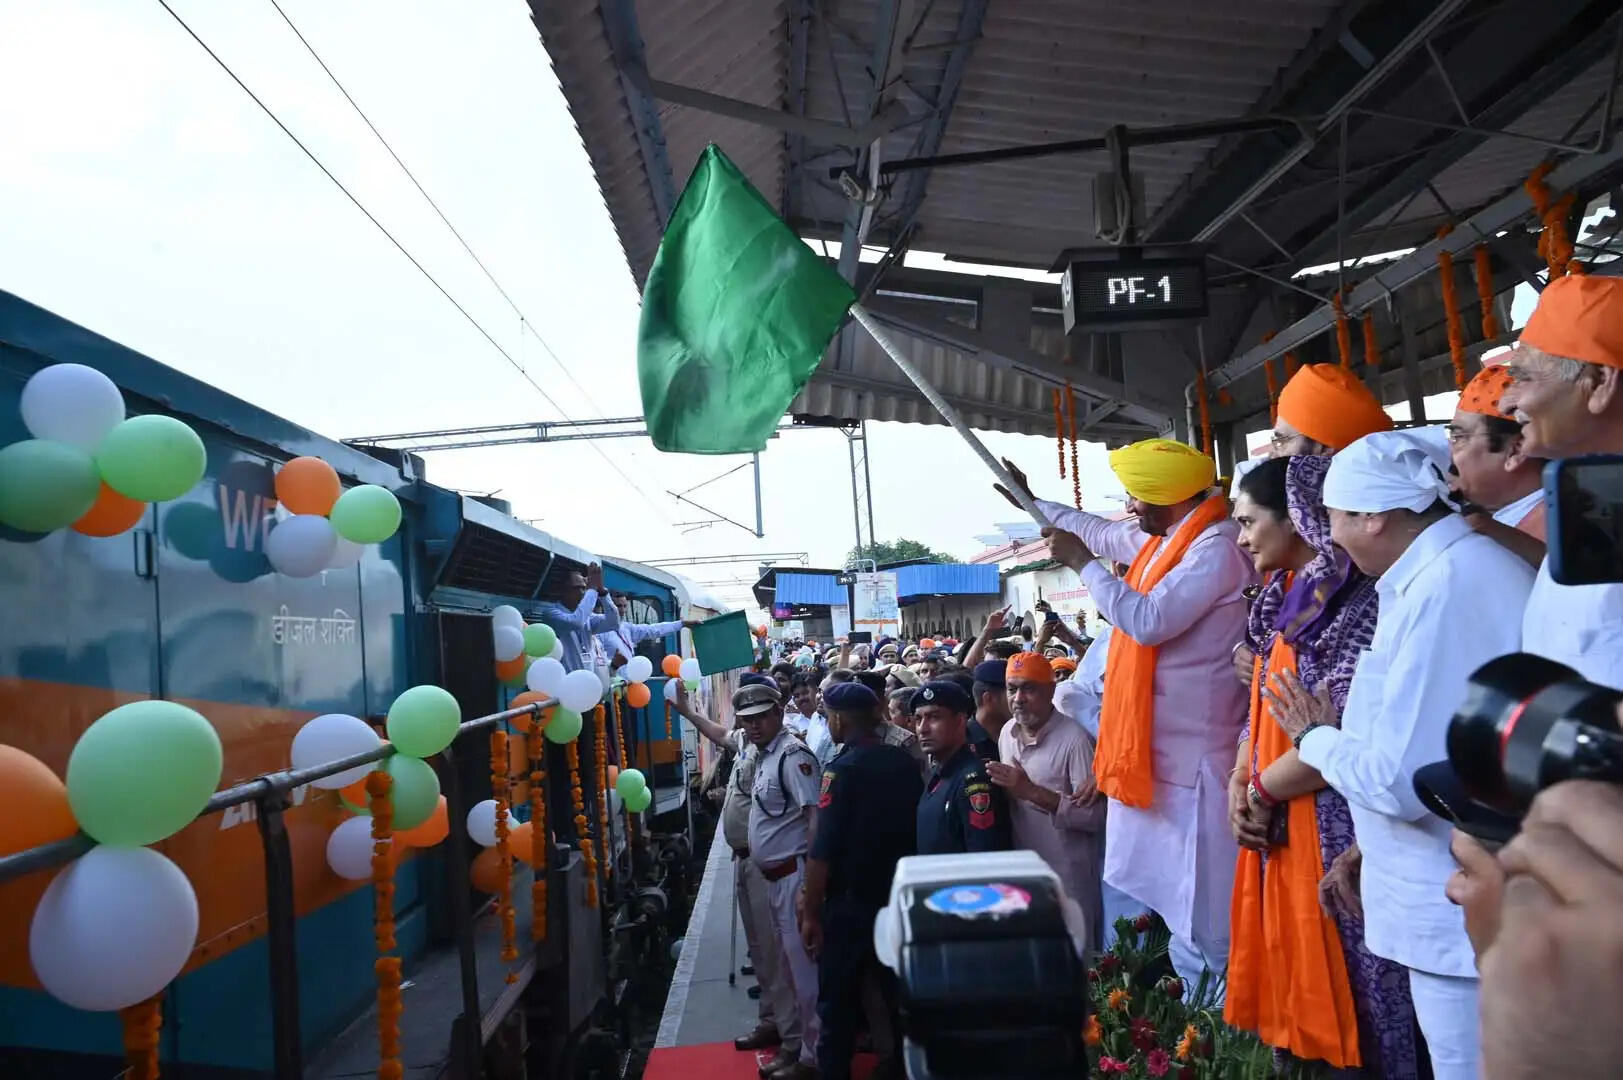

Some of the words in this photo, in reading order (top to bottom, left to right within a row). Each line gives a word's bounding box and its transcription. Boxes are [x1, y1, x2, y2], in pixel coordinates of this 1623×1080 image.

[1108, 276, 1171, 304] PF-1
[272, 604, 317, 645] डीजल
[320, 608, 356, 645] शक्ति
